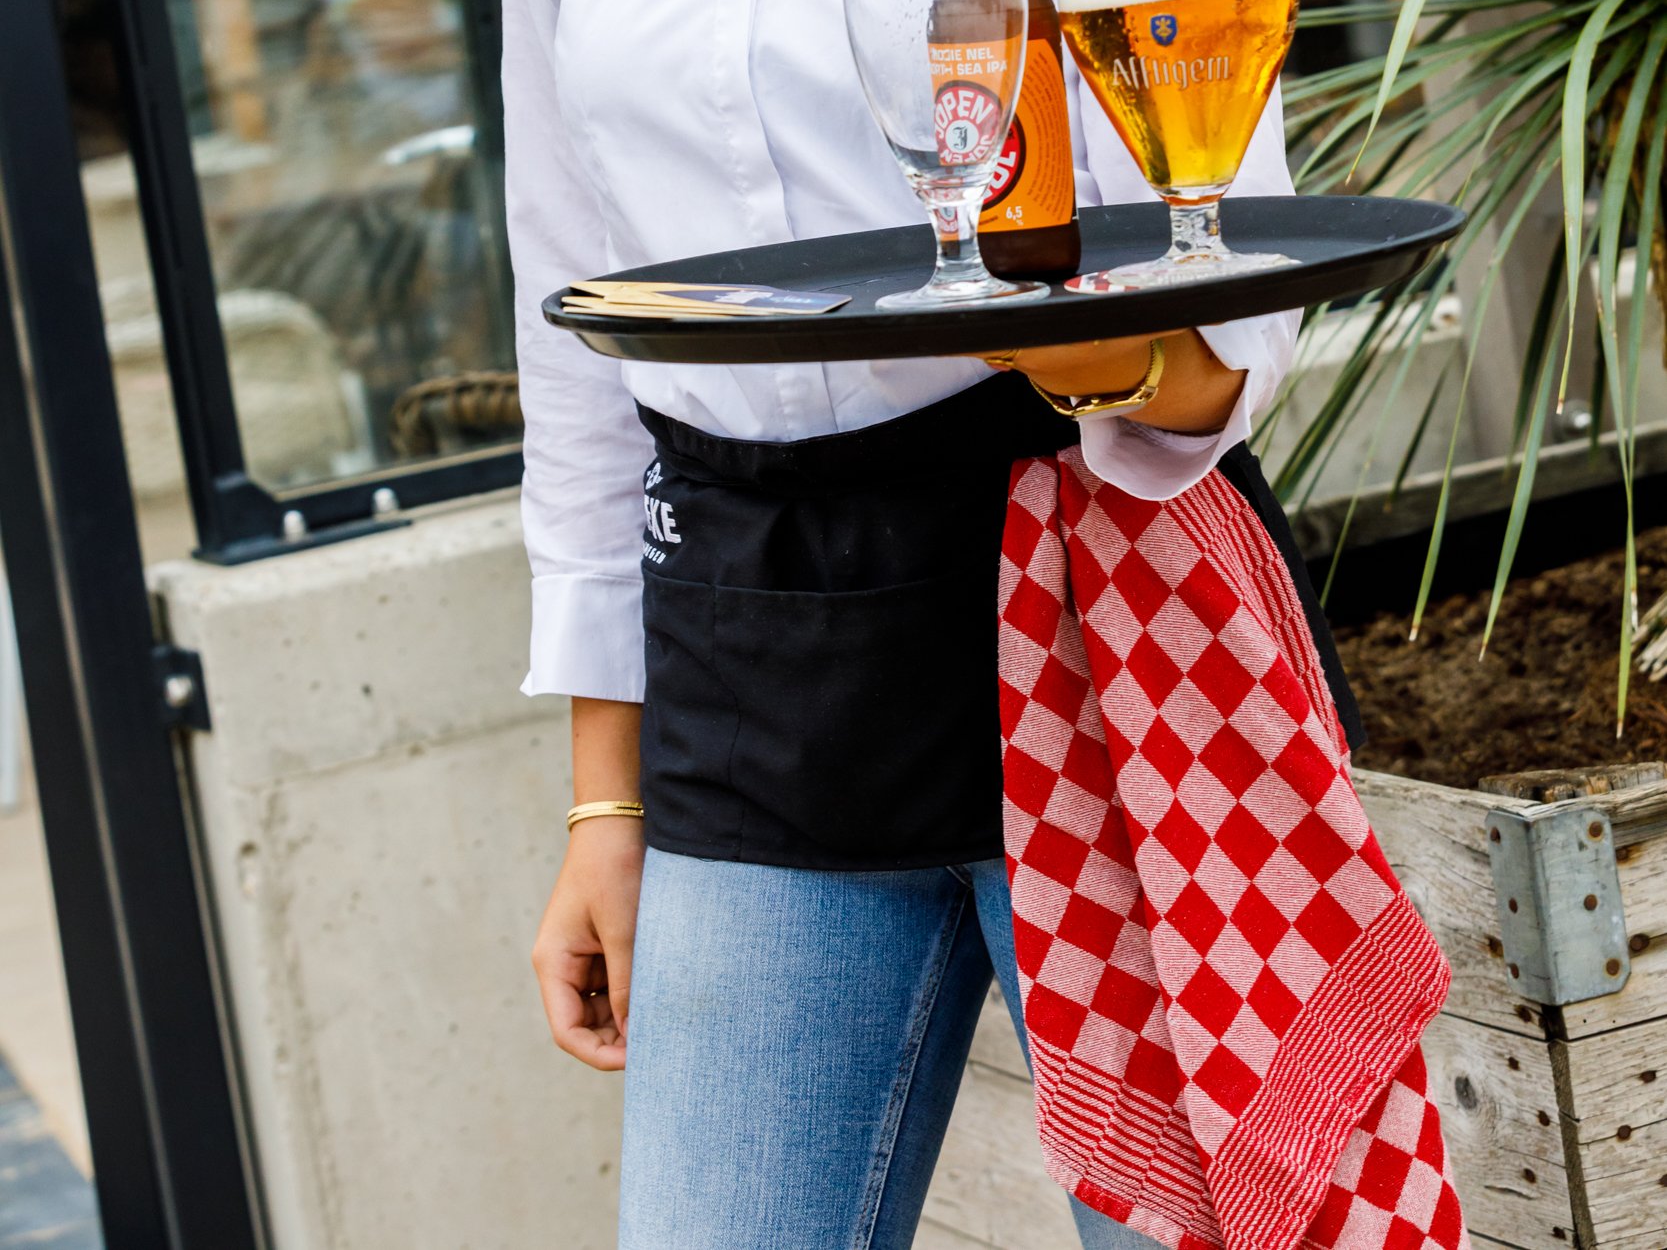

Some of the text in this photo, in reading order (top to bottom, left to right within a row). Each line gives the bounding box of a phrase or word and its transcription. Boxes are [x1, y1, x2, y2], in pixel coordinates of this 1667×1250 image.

[966, 47, 994, 61] NEL
[957, 62, 983, 76] SEA
[986, 60, 1008, 74] IPA
[1112, 56, 1230, 90] Affligem
[935, 90, 994, 139] JOPEN
[1006, 206, 1023, 221] 6,5
[644, 494, 682, 544] EKE
